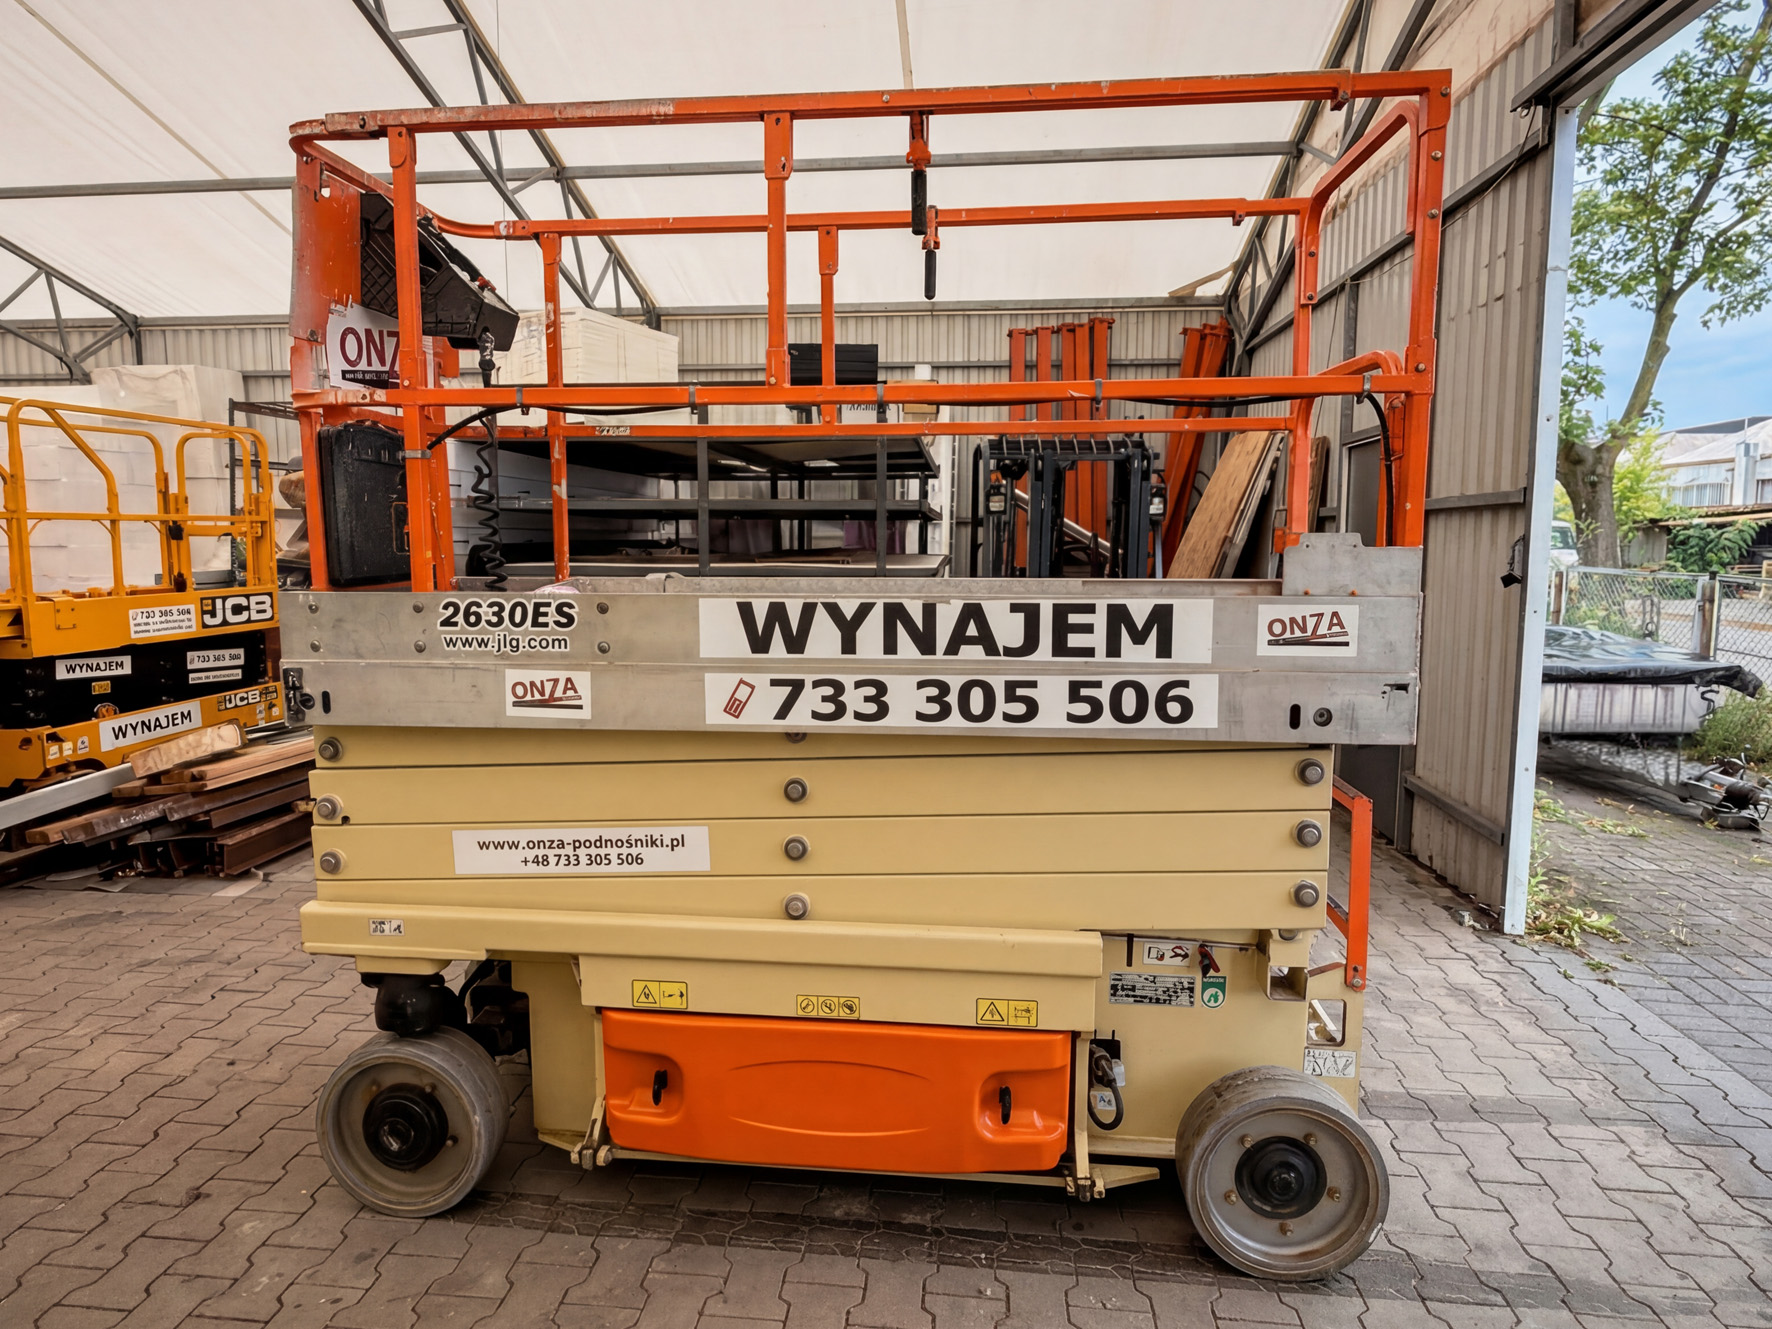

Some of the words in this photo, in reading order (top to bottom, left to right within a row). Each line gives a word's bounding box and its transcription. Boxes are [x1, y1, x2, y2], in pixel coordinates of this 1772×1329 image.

[202, 594, 273, 626] JCB
[439, 600, 577, 629] 2630ES
[736, 601, 1174, 659] WYNAJEM
[1267, 611, 1346, 637] ONZA
[443, 633, 568, 653] www.jlg.com
[65, 660, 124, 675] WYNAJEM
[225, 689, 261, 709] JCB
[511, 677, 579, 700] ONZA
[768, 678, 890, 722] 733
[914, 679, 1040, 724] 305
[1065, 680, 1194, 725] 506
[111, 709, 193, 741] WYNAJEM
[477, 833, 686, 852] www.onza-podnośniki.pl
[520, 854, 550, 867] +48
[553, 854, 580, 867] 733
[585, 853, 612, 866] 305
[616, 852, 644, 866] 506
